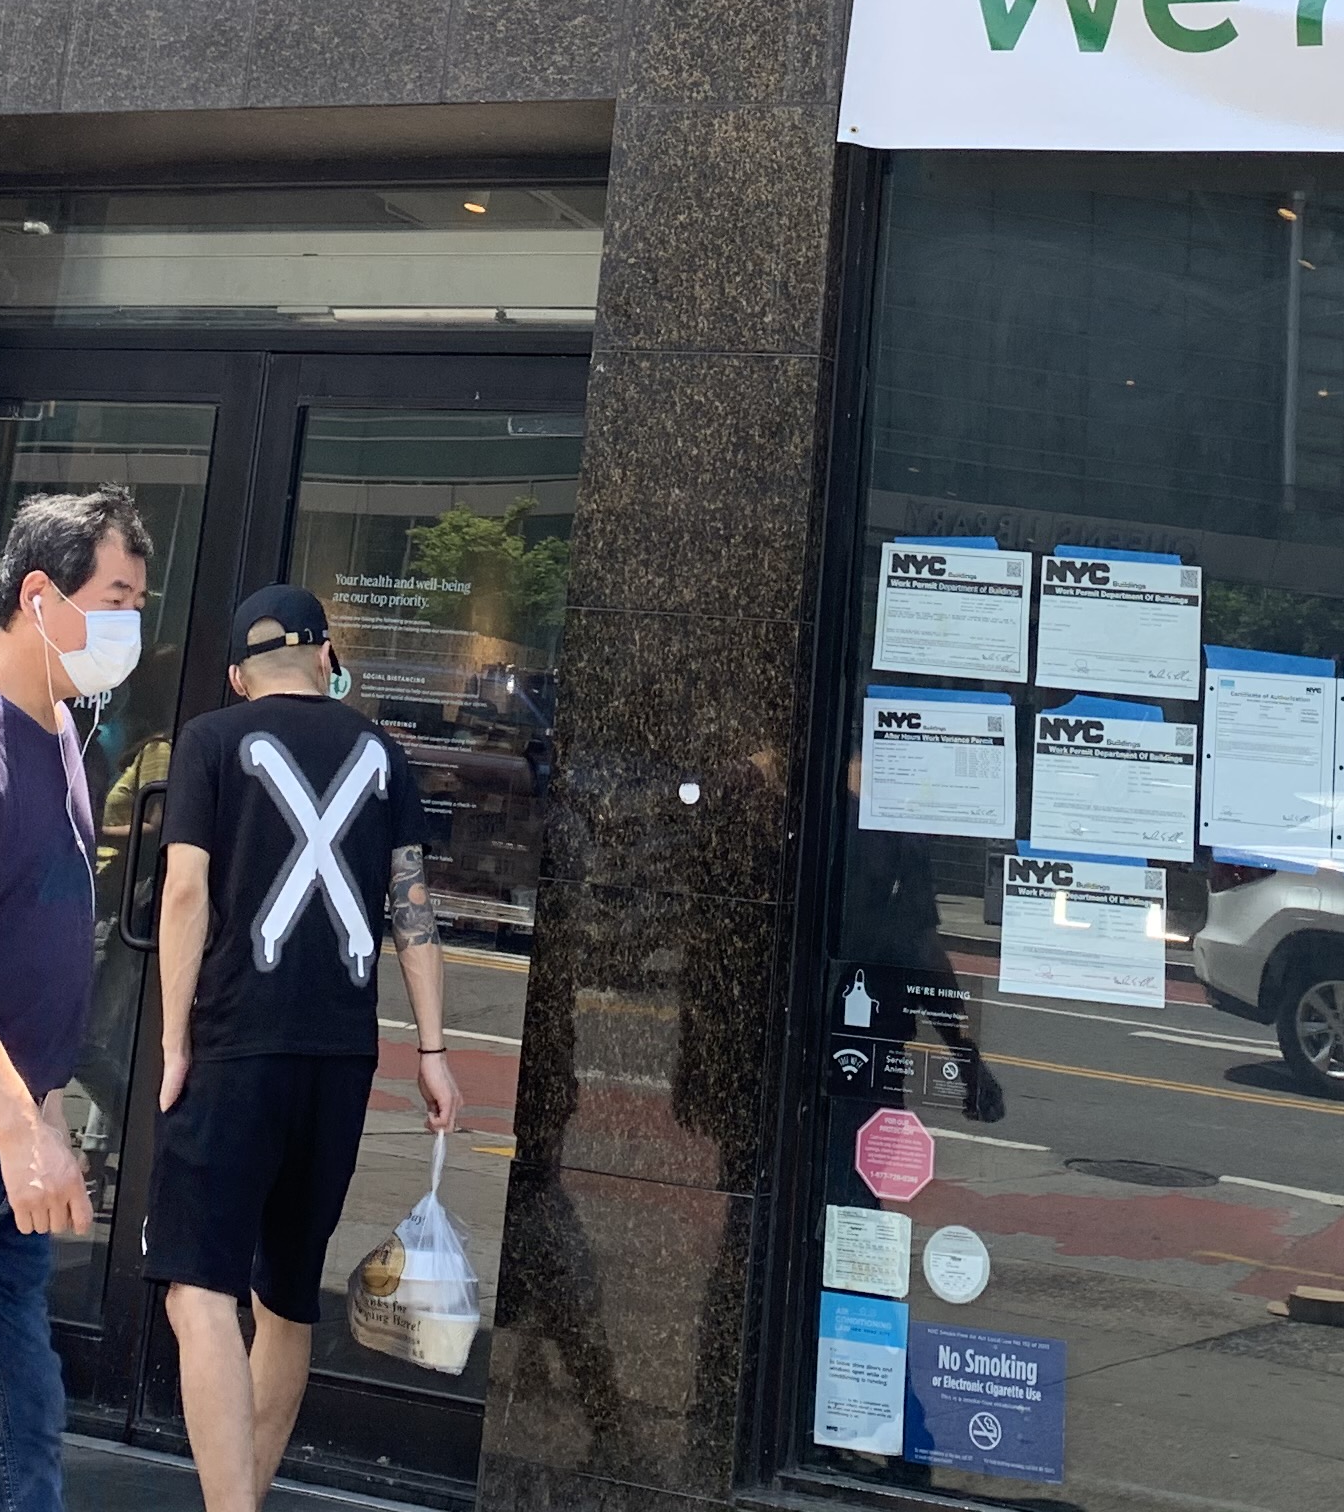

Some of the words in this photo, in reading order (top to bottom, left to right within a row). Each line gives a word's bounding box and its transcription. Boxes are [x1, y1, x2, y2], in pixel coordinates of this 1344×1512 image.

[891, 552, 947, 576] NYC
[1046, 559, 1110, 586] NYC
[335, 573, 358, 586] Your
[360, 574, 393, 589] health
[394, 577, 414, 590] and
[416, 578, 471, 595] well-being
[890, 579, 911, 588] Work
[912, 580, 938, 590] Permit
[939, 583, 978, 593] Department
[988, 587, 1020, 597] Buildings
[332, 593, 349, 602] are
[350, 594, 368, 604] our
[370, 592, 387, 607] top
[388, 593, 430, 609] priority.
[1055, 587, 1075, 596] Work
[1075, 589, 1100, 598] Permit
[1101, 591, 1144, 601] Department
[1155, 595, 1189, 606] Buildings
[878, 711, 921, 729] NYC
[1040, 717, 1105, 744] NYC
[1048, 745, 1068, 754] Work
[1069, 747, 1094, 756] Permit
[1094, 749, 1138, 760] Department
[1149, 754, 1184, 764] Buildings
[1008, 858, 1074, 886] NYC
[1017, 887, 1038, 896] Work
[937, 989, 971, 1001] HIRING
[884, 1064, 915, 1076] Animals
[885, 1055, 914, 1066] Service
[938, 1345, 960, 1371] No
[965, 1349, 1038, 1386] Smoking
[932, 1377, 941, 1387] or
[943, 1375, 984, 1393] Electronic
[985, 1381, 1024, 1400] Cigarette
[1025, 1388, 1042, 1401] Use
